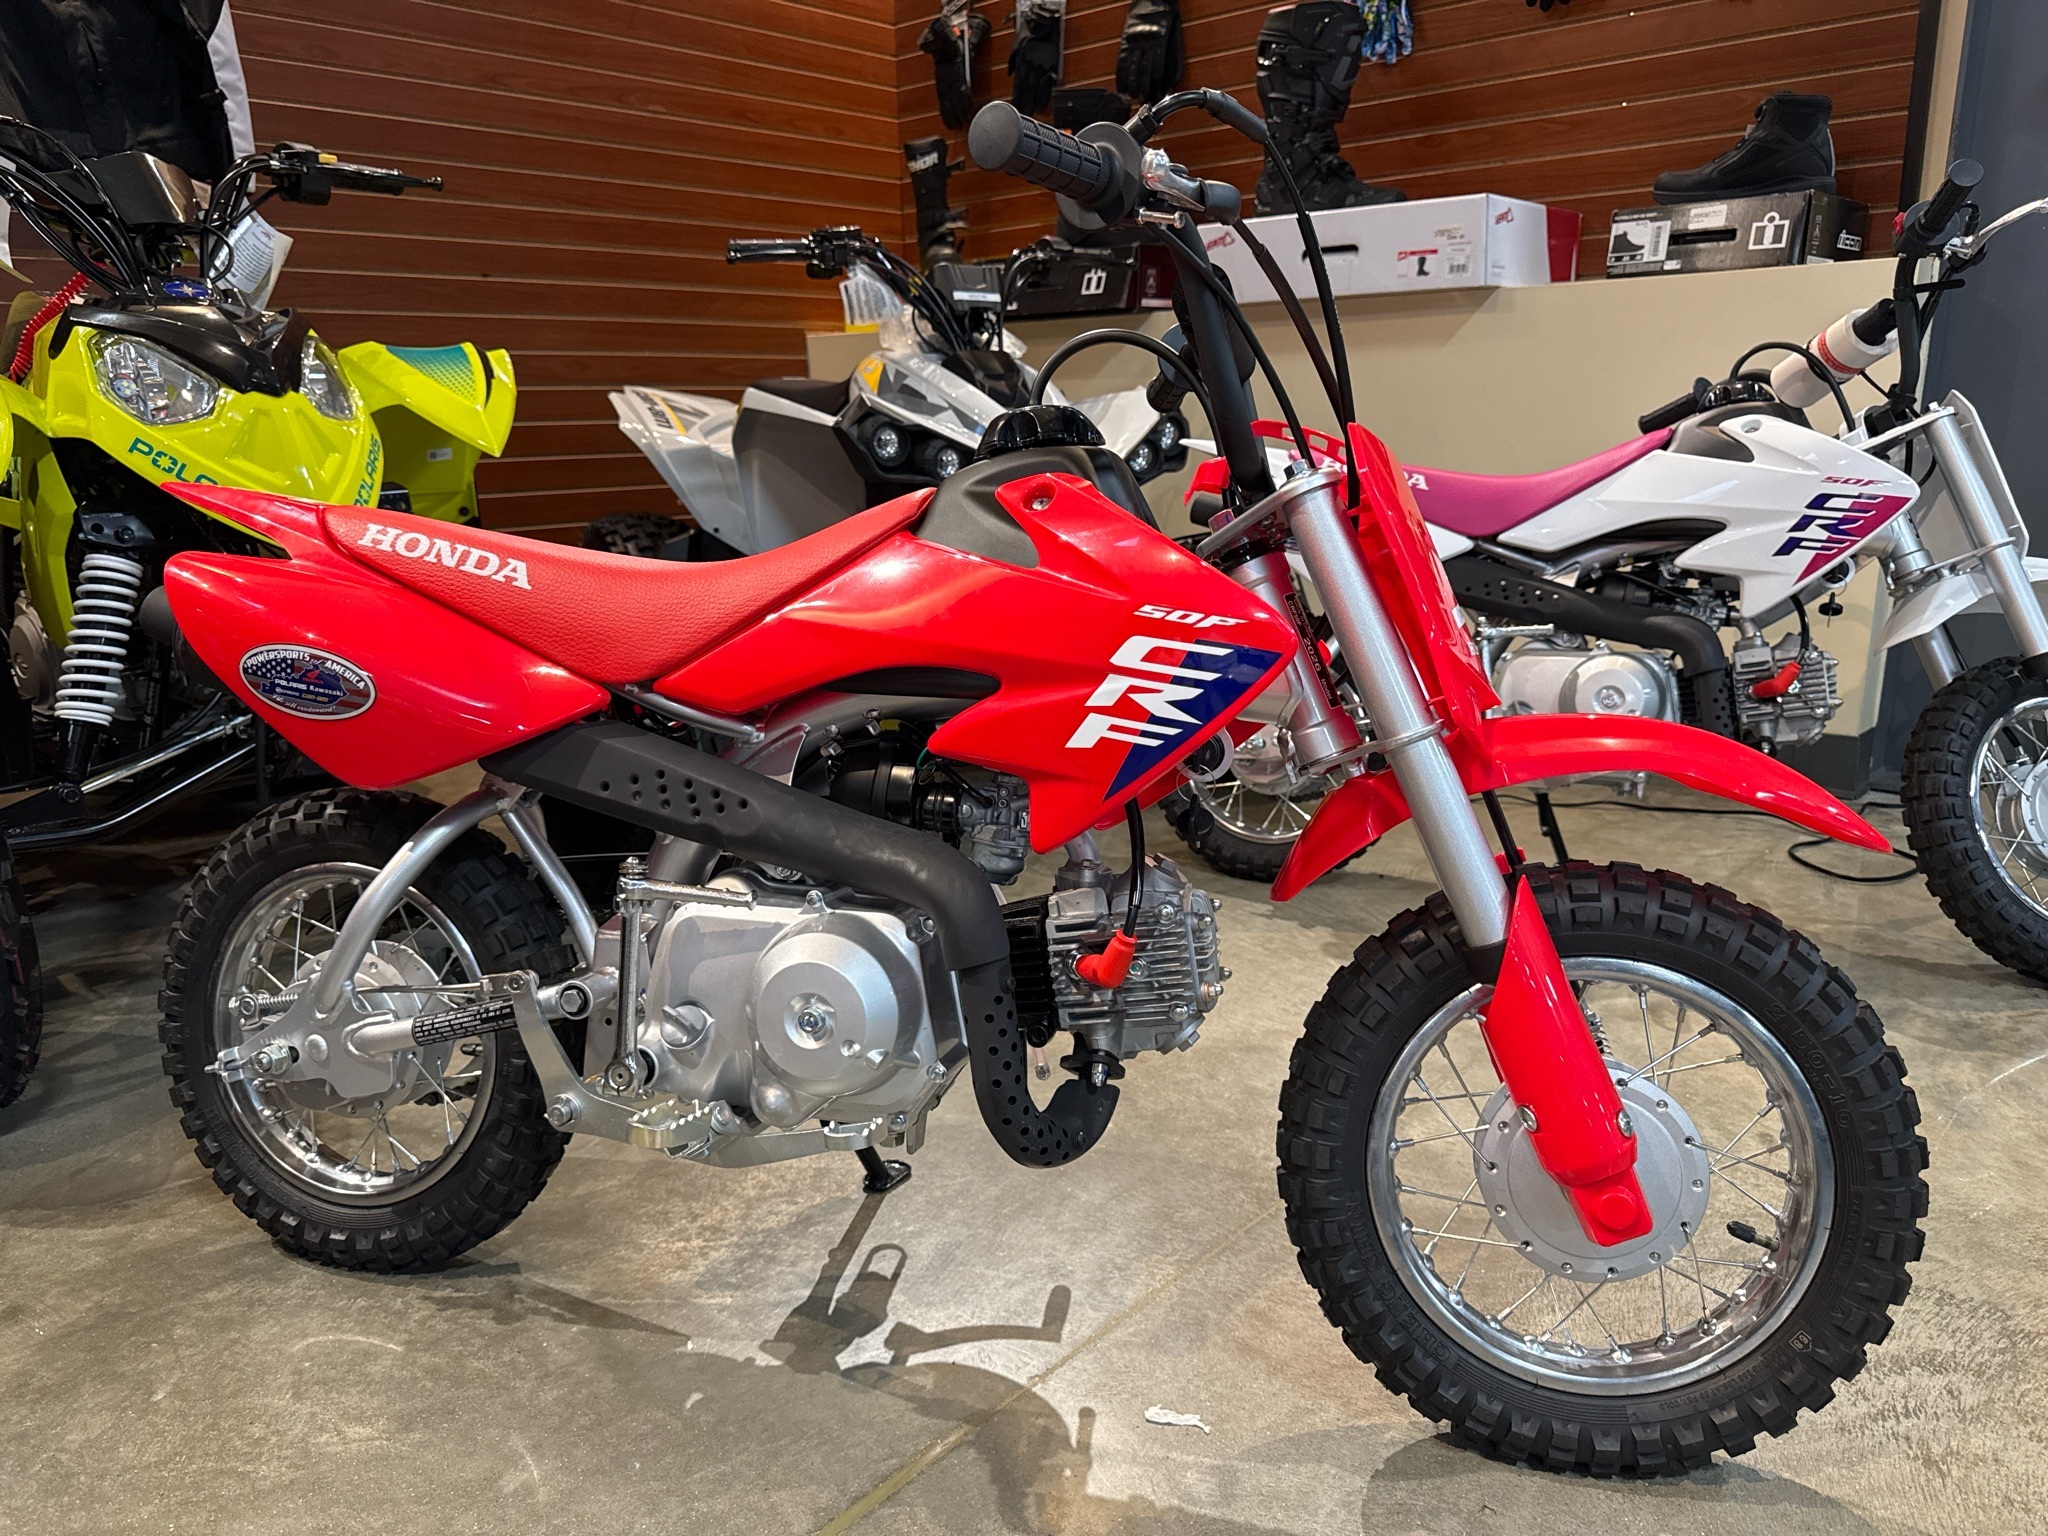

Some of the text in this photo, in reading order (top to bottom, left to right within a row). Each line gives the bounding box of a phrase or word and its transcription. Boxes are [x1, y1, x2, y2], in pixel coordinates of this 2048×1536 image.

[1771, 492, 1884, 557] CRF
[357, 523, 532, 590] HONDA
[1133, 604, 1250, 628] 50F
[246, 650, 310, 668] POWERSPORTS
[325, 660, 366, 690] AMERICA
[1303, 637, 1322, 672] 2026
[274, 678, 344, 697] POLARIS Kawasaki
[1065, 635, 1235, 748] CRF
